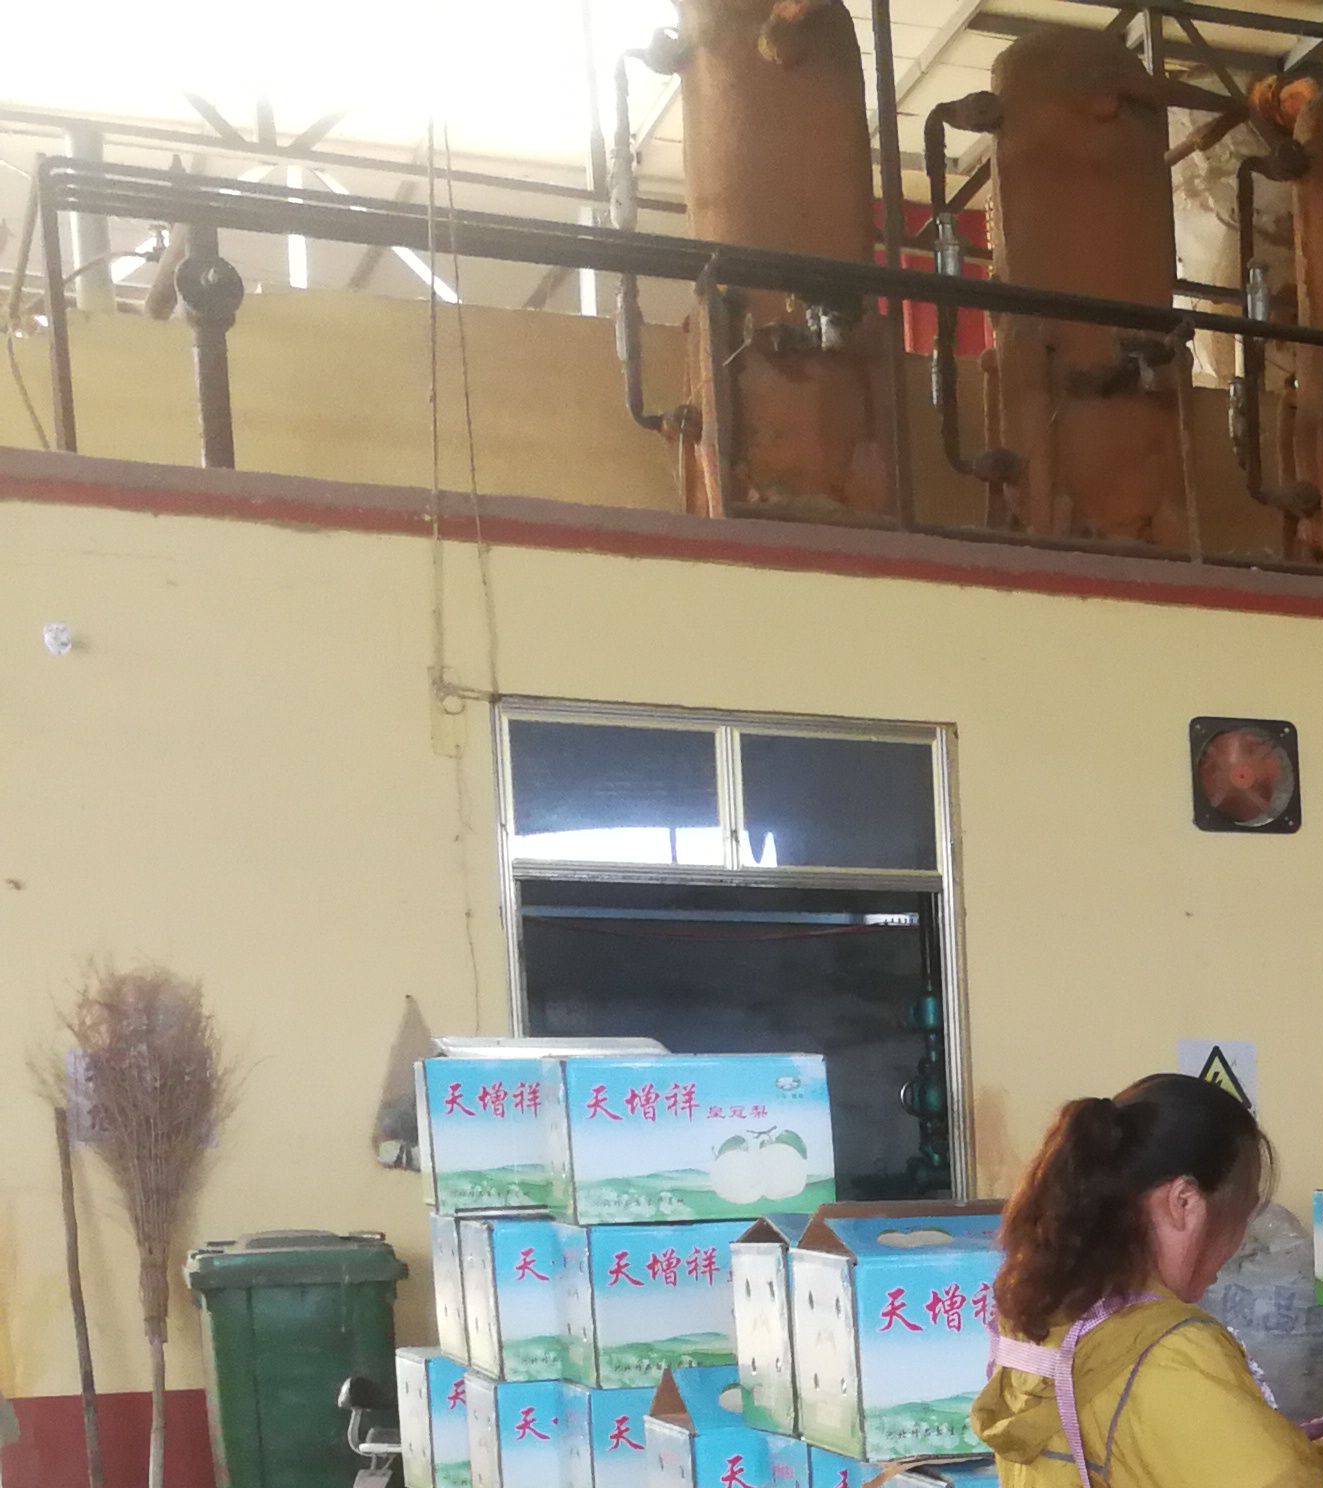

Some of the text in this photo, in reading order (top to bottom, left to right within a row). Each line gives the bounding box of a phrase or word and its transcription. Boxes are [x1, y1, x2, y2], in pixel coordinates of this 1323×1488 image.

[445, 1082, 541, 1120] 天增祥
[586, 1083, 701, 1122] 天增祥
[608, 1247, 721, 1288] 天增祥
